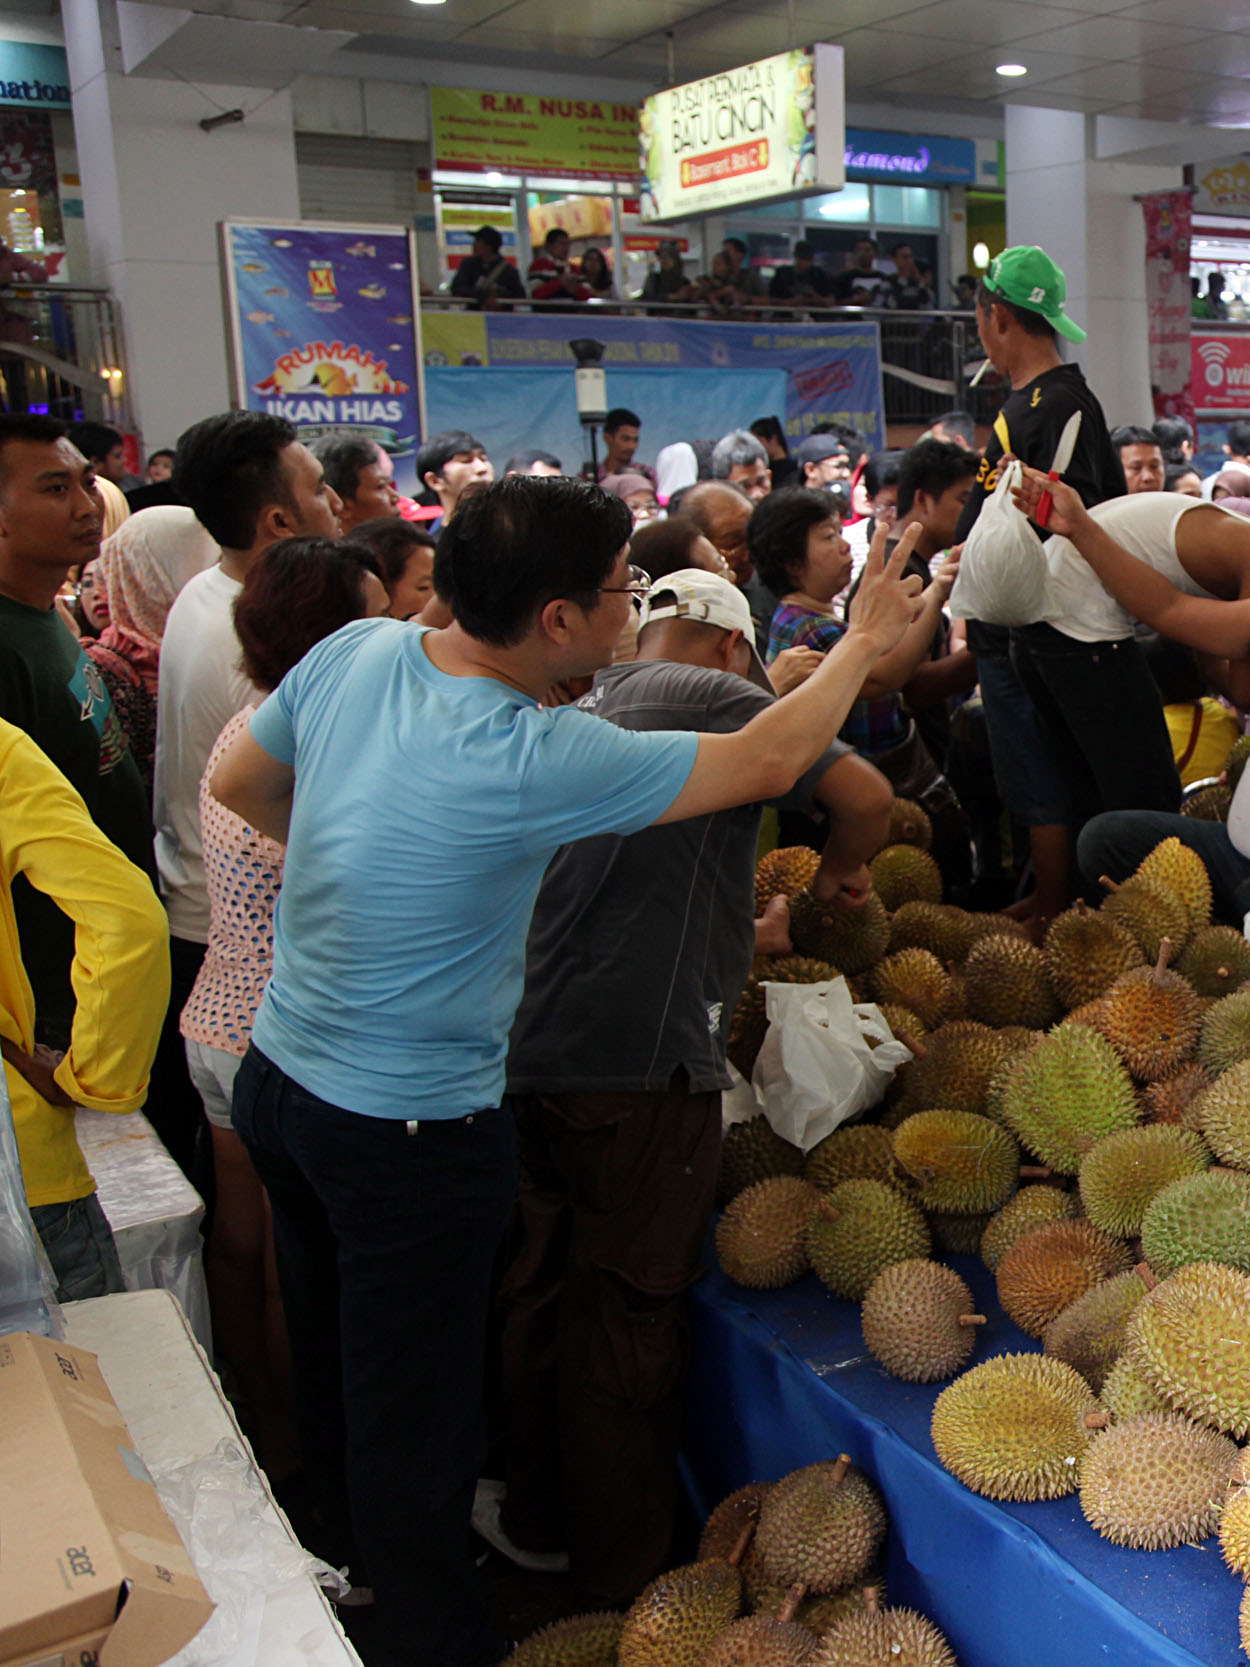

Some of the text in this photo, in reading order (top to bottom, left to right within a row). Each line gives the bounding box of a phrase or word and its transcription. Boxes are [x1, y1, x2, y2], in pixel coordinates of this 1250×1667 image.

[481, 94, 532, 114] R.M.
[539, 99, 604, 120] NUSA
[276, 341, 387, 376] RUMAH
[266, 400, 403, 423] IKAN HIAS
[66, 1545, 96, 1577] acer
